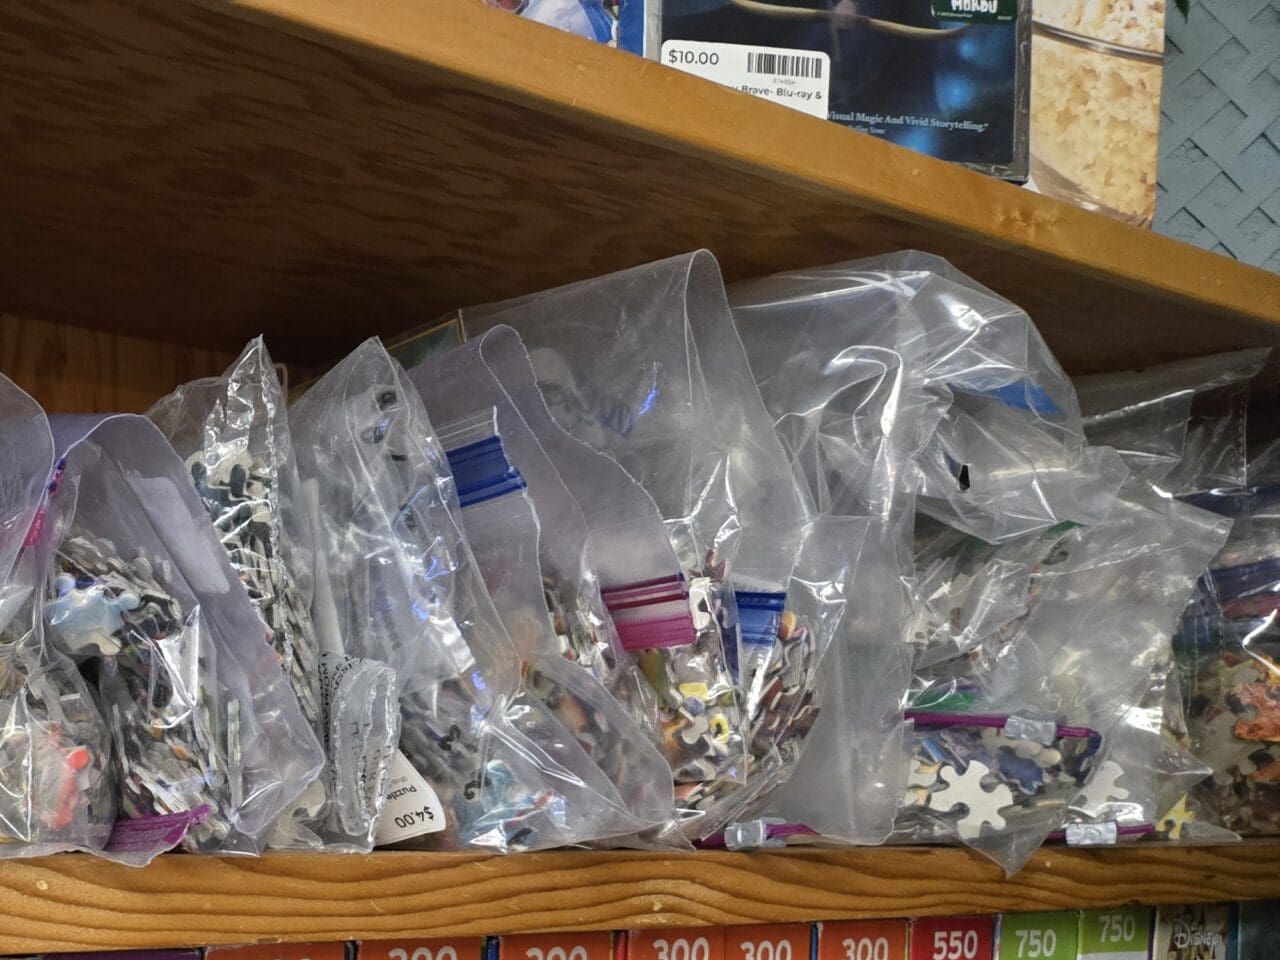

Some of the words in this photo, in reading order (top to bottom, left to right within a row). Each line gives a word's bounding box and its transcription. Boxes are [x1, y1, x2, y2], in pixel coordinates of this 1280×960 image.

[668, 49, 719, 66] $10.00
[776, 87, 812, 101] Blu-ray
[815, 91, 823, 100] &
[856, 112, 882, 125] Magic
[883, 115, 904, 125] And
[905, 116, 929, 127] Vivid
[394, 806, 434, 829] $4.00
[1099, 914, 1136, 943] 750
[1171, 918, 1221, 955] Disney
[933, 930, 978, 960] 550
[1015, 928, 1057, 958] 750
